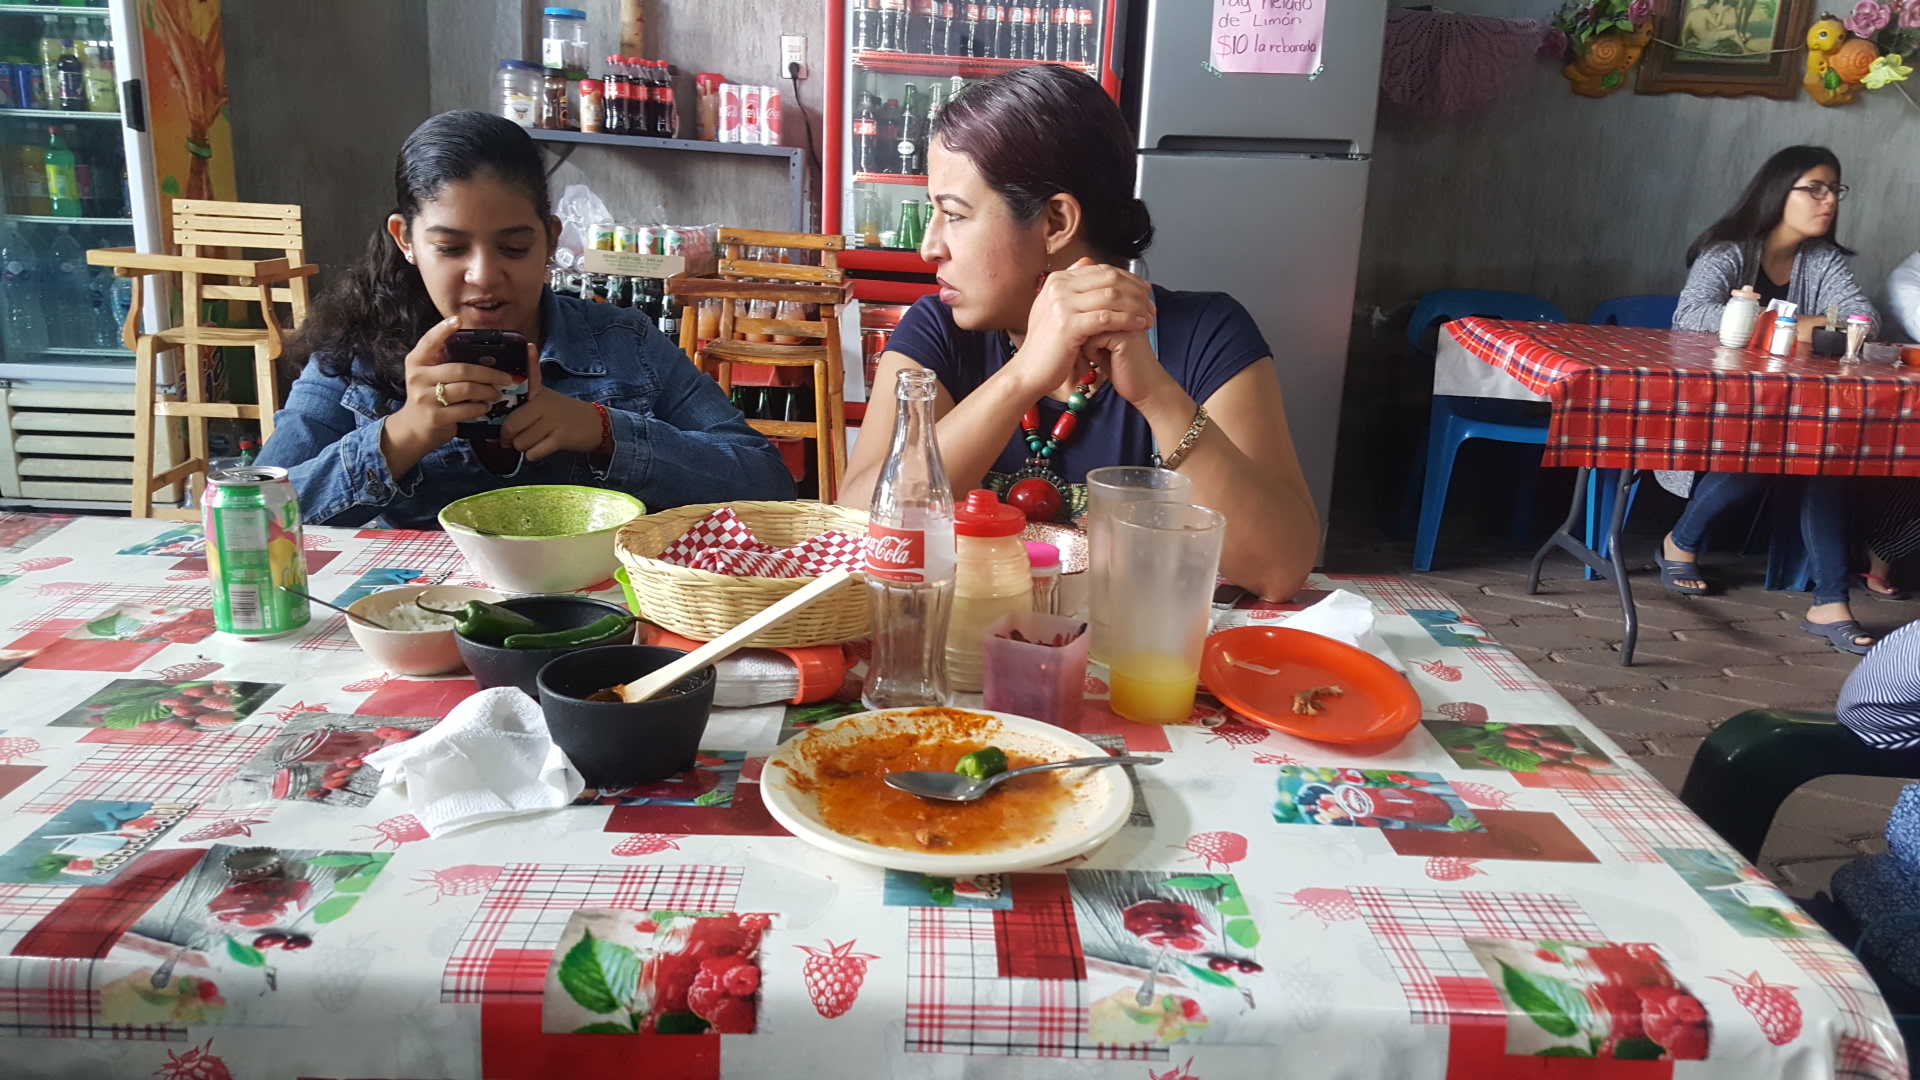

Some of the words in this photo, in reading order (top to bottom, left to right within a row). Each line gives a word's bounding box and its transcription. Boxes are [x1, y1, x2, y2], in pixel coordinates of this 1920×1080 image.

[1219, 13, 1240, 28] de
[1253, 12, 1302, 27] Limón
[1216, 34, 1249, 58] $10
[1254, 34, 1266, 53] la
[1269, 37, 1317, 53] rebanada
[865, 534, 913, 564] ca-Cola
